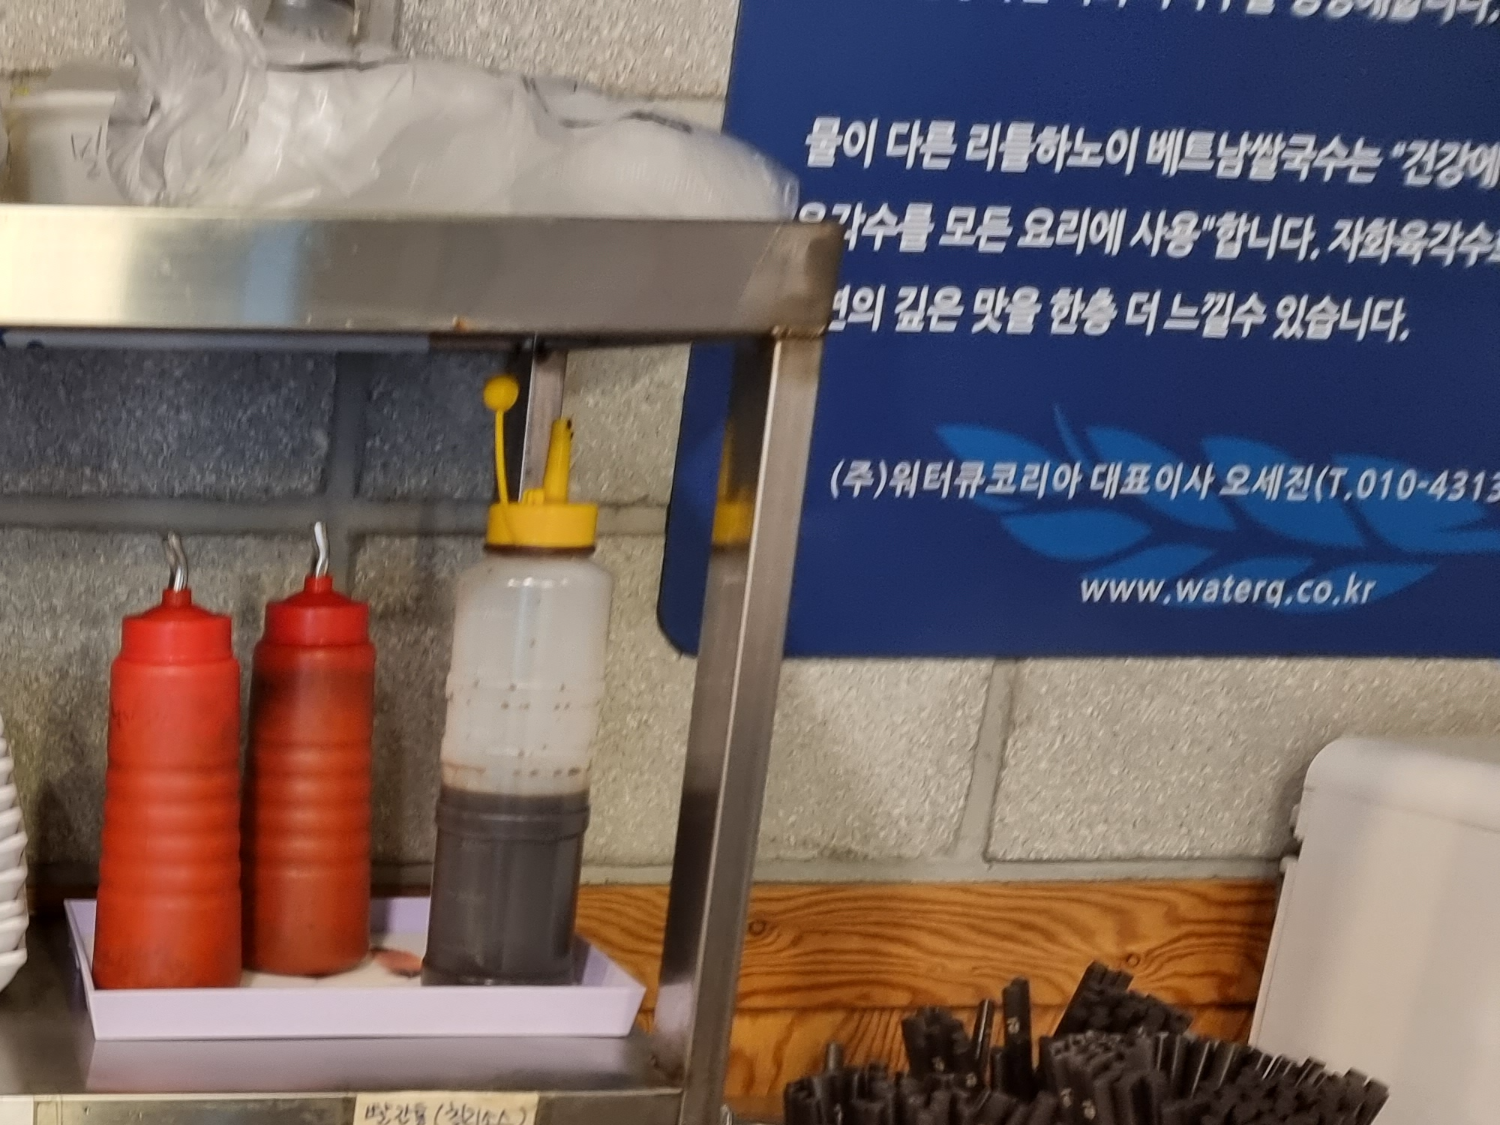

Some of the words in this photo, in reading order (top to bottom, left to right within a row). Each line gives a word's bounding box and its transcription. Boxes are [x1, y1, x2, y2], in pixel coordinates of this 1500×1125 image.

[805, 116, 878, 169] 물이
[886, 119, 958, 170] 다른
[965, 121, 1141, 176] 리틀하노이
[1146, 127, 1384, 184] 베트남쌀국수는
[939, 205, 1013, 253] 모든
[1017, 207, 1128, 256] 요리에
[1328, 215, 1500, 268] 자화육각수
[894, 284, 965, 333] 깊은
[971, 286, 1042, 335] 맛을
[1050, 287, 1118, 336] 한층
[1125, 289, 1161, 337] 더
[1273, 293, 1410, 342] 있습니다.
[830, 459, 1082, 499] (주)워터큐코리아
[1089, 460, 1216, 501] 대표이사
